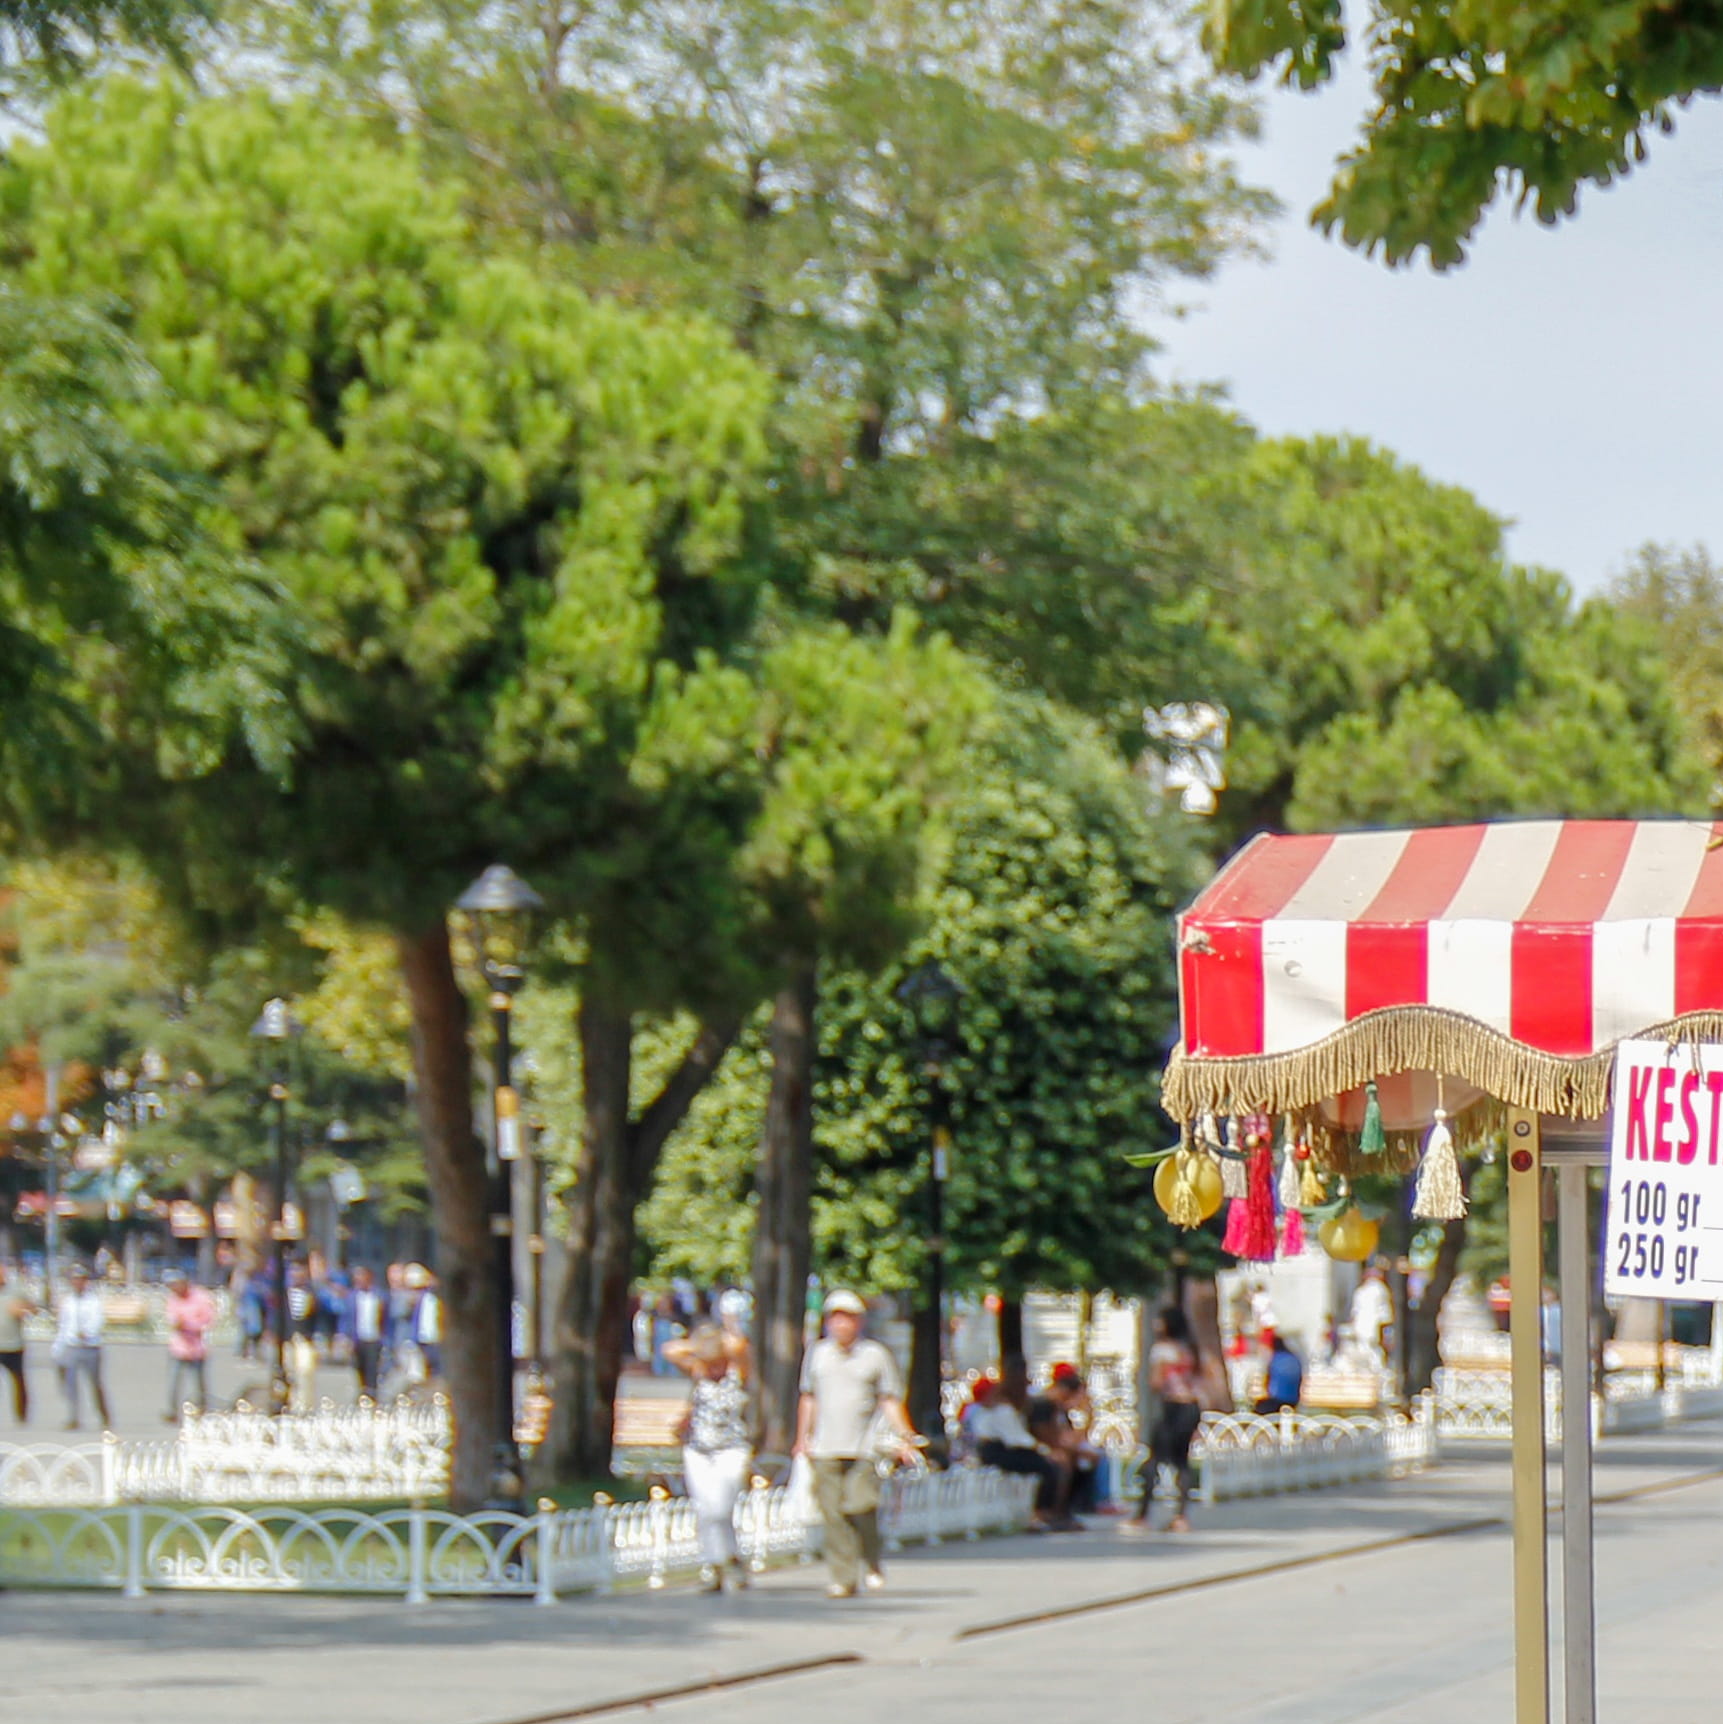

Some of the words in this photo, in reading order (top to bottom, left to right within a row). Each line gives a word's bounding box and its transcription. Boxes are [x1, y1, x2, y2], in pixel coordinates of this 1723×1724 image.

[1621, 1180, 1667, 1226] 100
[1677, 1192, 1701, 1232] gr
[1617, 1232, 1665, 1279] 250
[1675, 1245, 1699, 1285] gr
